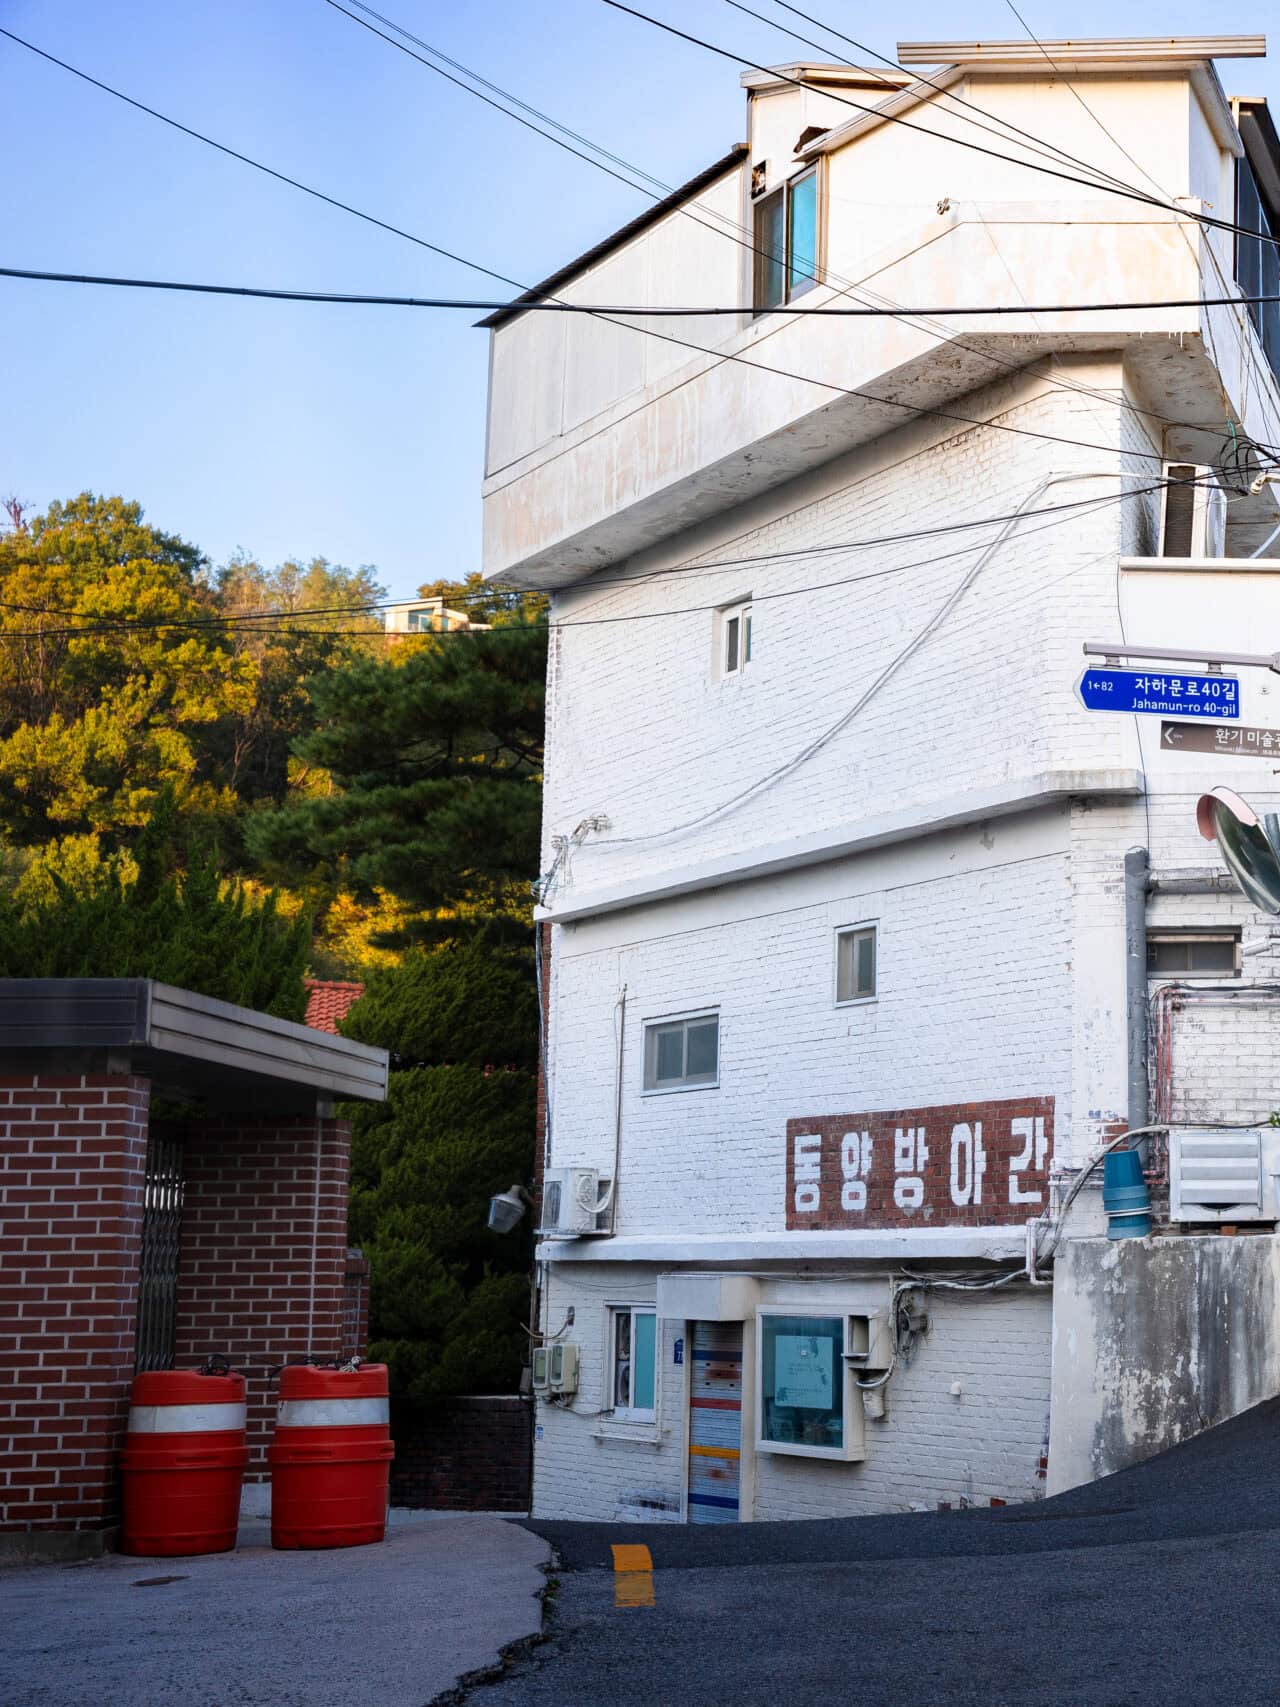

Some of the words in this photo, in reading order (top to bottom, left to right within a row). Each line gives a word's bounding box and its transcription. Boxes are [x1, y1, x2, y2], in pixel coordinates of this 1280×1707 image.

[1135, 677, 1235, 701] 자하문로40길
[1131, 698, 1200, 713] Jahamun-ro
[1203, 702, 1236, 716] 40-gil
[794, 1116, 1048, 1212] 동양방아간
